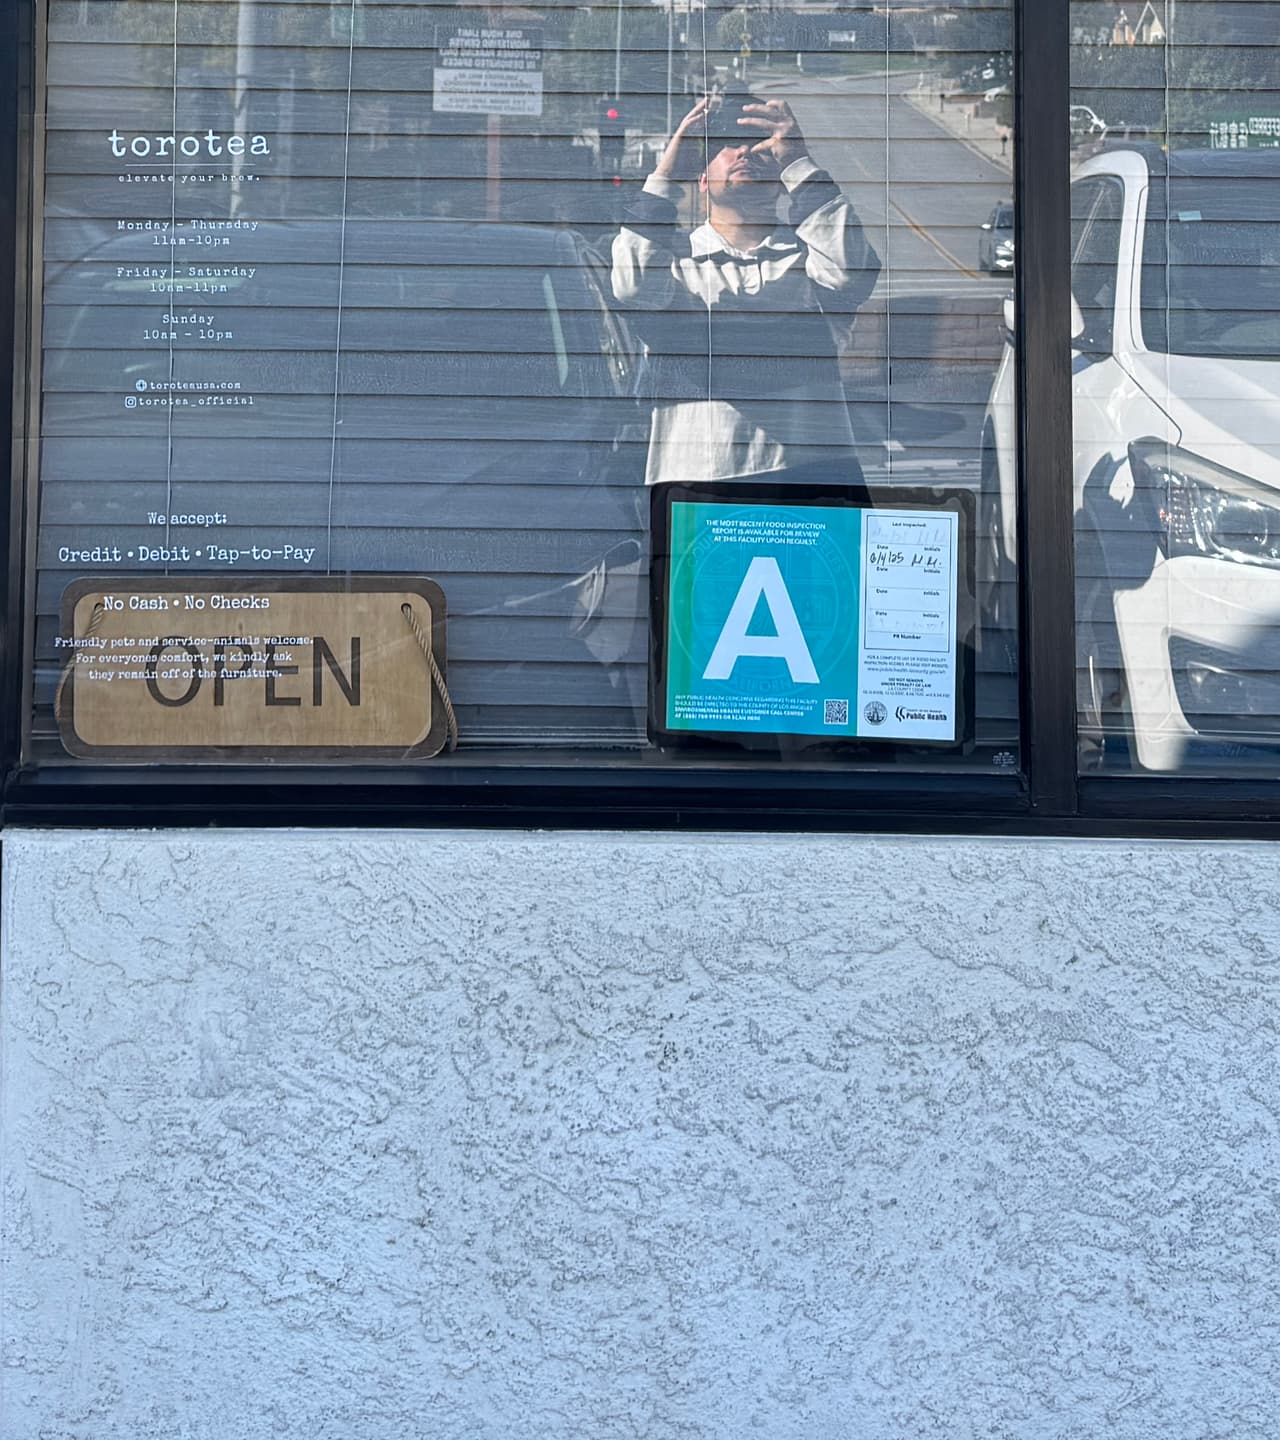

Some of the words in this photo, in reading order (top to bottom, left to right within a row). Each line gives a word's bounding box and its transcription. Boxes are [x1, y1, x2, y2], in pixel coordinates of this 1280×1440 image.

[108, 129, 270, 156] torotea
[182, 175, 214, 183] your
[117, 220, 169, 231] Monday
[190, 220, 258, 230] Thursday
[153, 235, 230, 247] 11am-10pm
[117, 267, 167, 279] Friday
[188, 267, 256, 278] Saturday
[150, 283, 228, 294] 10am-11pm
[163, 314, 214, 325] Sunday
[144, 330, 177, 339] 10am
[199, 329, 233, 341] 10pm
[147, 512, 166, 525] We
[170, 512, 227, 527] accept:
[58, 546, 122, 562] Credit
[139, 546, 190, 561] Debit
[206, 545, 315, 564] Tap-to-Pay
[104, 596, 124, 610] No
[129, 596, 168, 610] Cash
[184, 595, 205, 609] No
[211, 595, 270, 609] Checks
[702, 556, 820, 684] A
[54, 637, 107, 648] Friendly
[111, 638, 135, 648] pets
[138, 637, 159, 646] and
[264, 636, 313, 644] welcome.
[76, 653, 96, 663] For
[160, 652, 209, 664] comfort,
[230, 651, 270, 663] kindly
[273, 651, 292, 661] ask
[89, 670, 115, 680] they
[118, 670, 158, 678] remain
[161, 669, 180, 678] off
[182, 669, 196, 678] of
[198, 668, 216, 678] the
[220, 668, 283, 678] furniture.
[144, 635, 361, 708] OPEN
